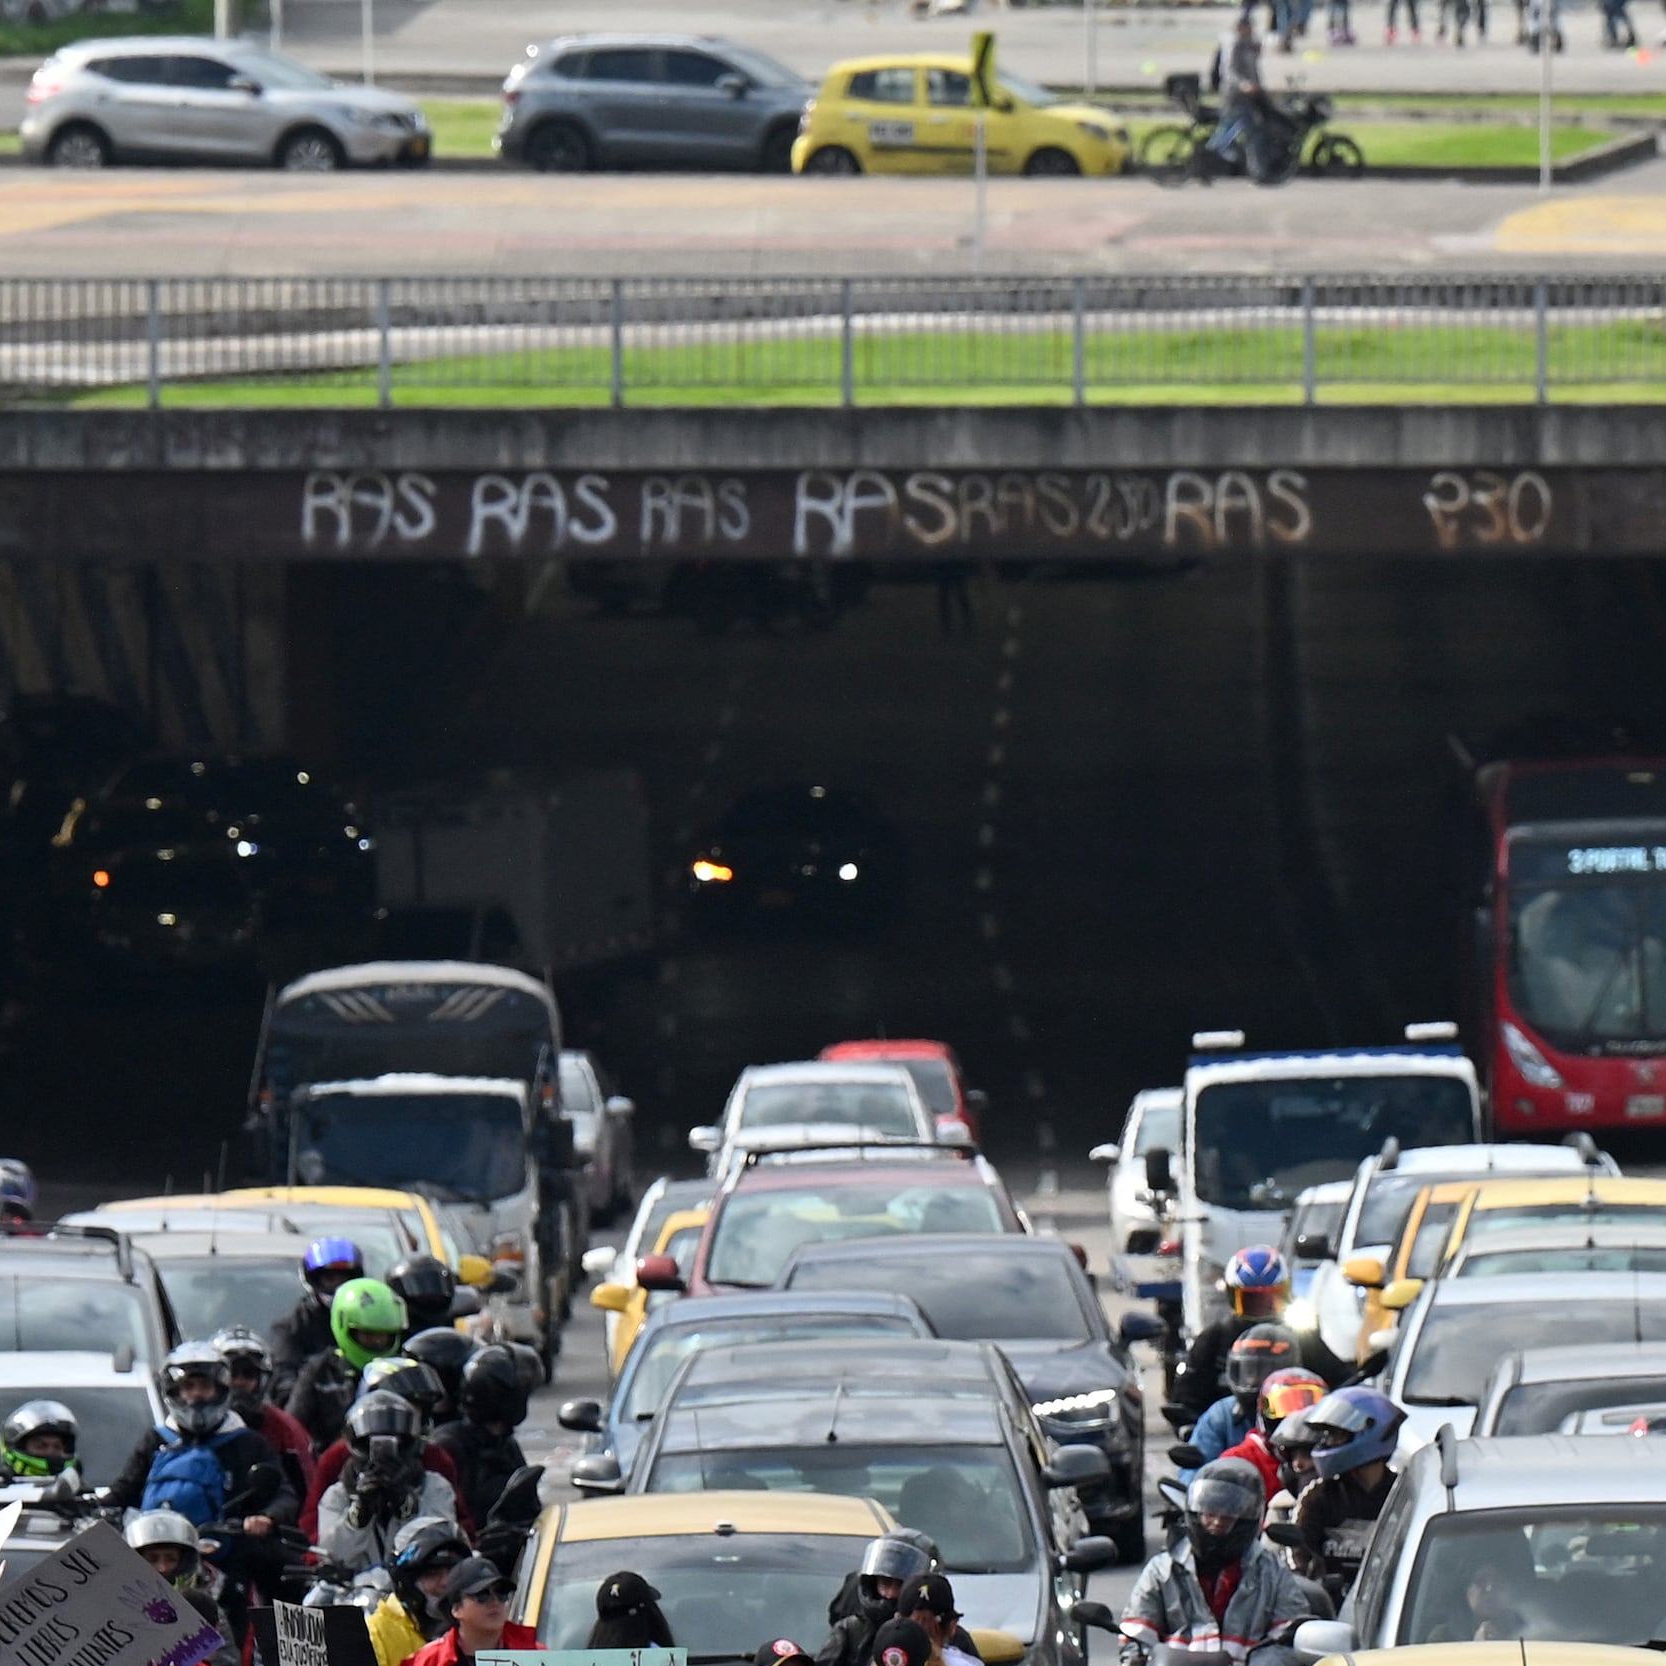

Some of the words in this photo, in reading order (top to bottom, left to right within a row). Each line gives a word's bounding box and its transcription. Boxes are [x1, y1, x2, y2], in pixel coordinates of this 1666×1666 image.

[303, 472, 436, 545] RAS
[467, 472, 617, 554] RAS
[639, 476, 750, 544] RAS
[794, 470, 956, 555] RAS
[1165, 472, 1310, 545] RAS
